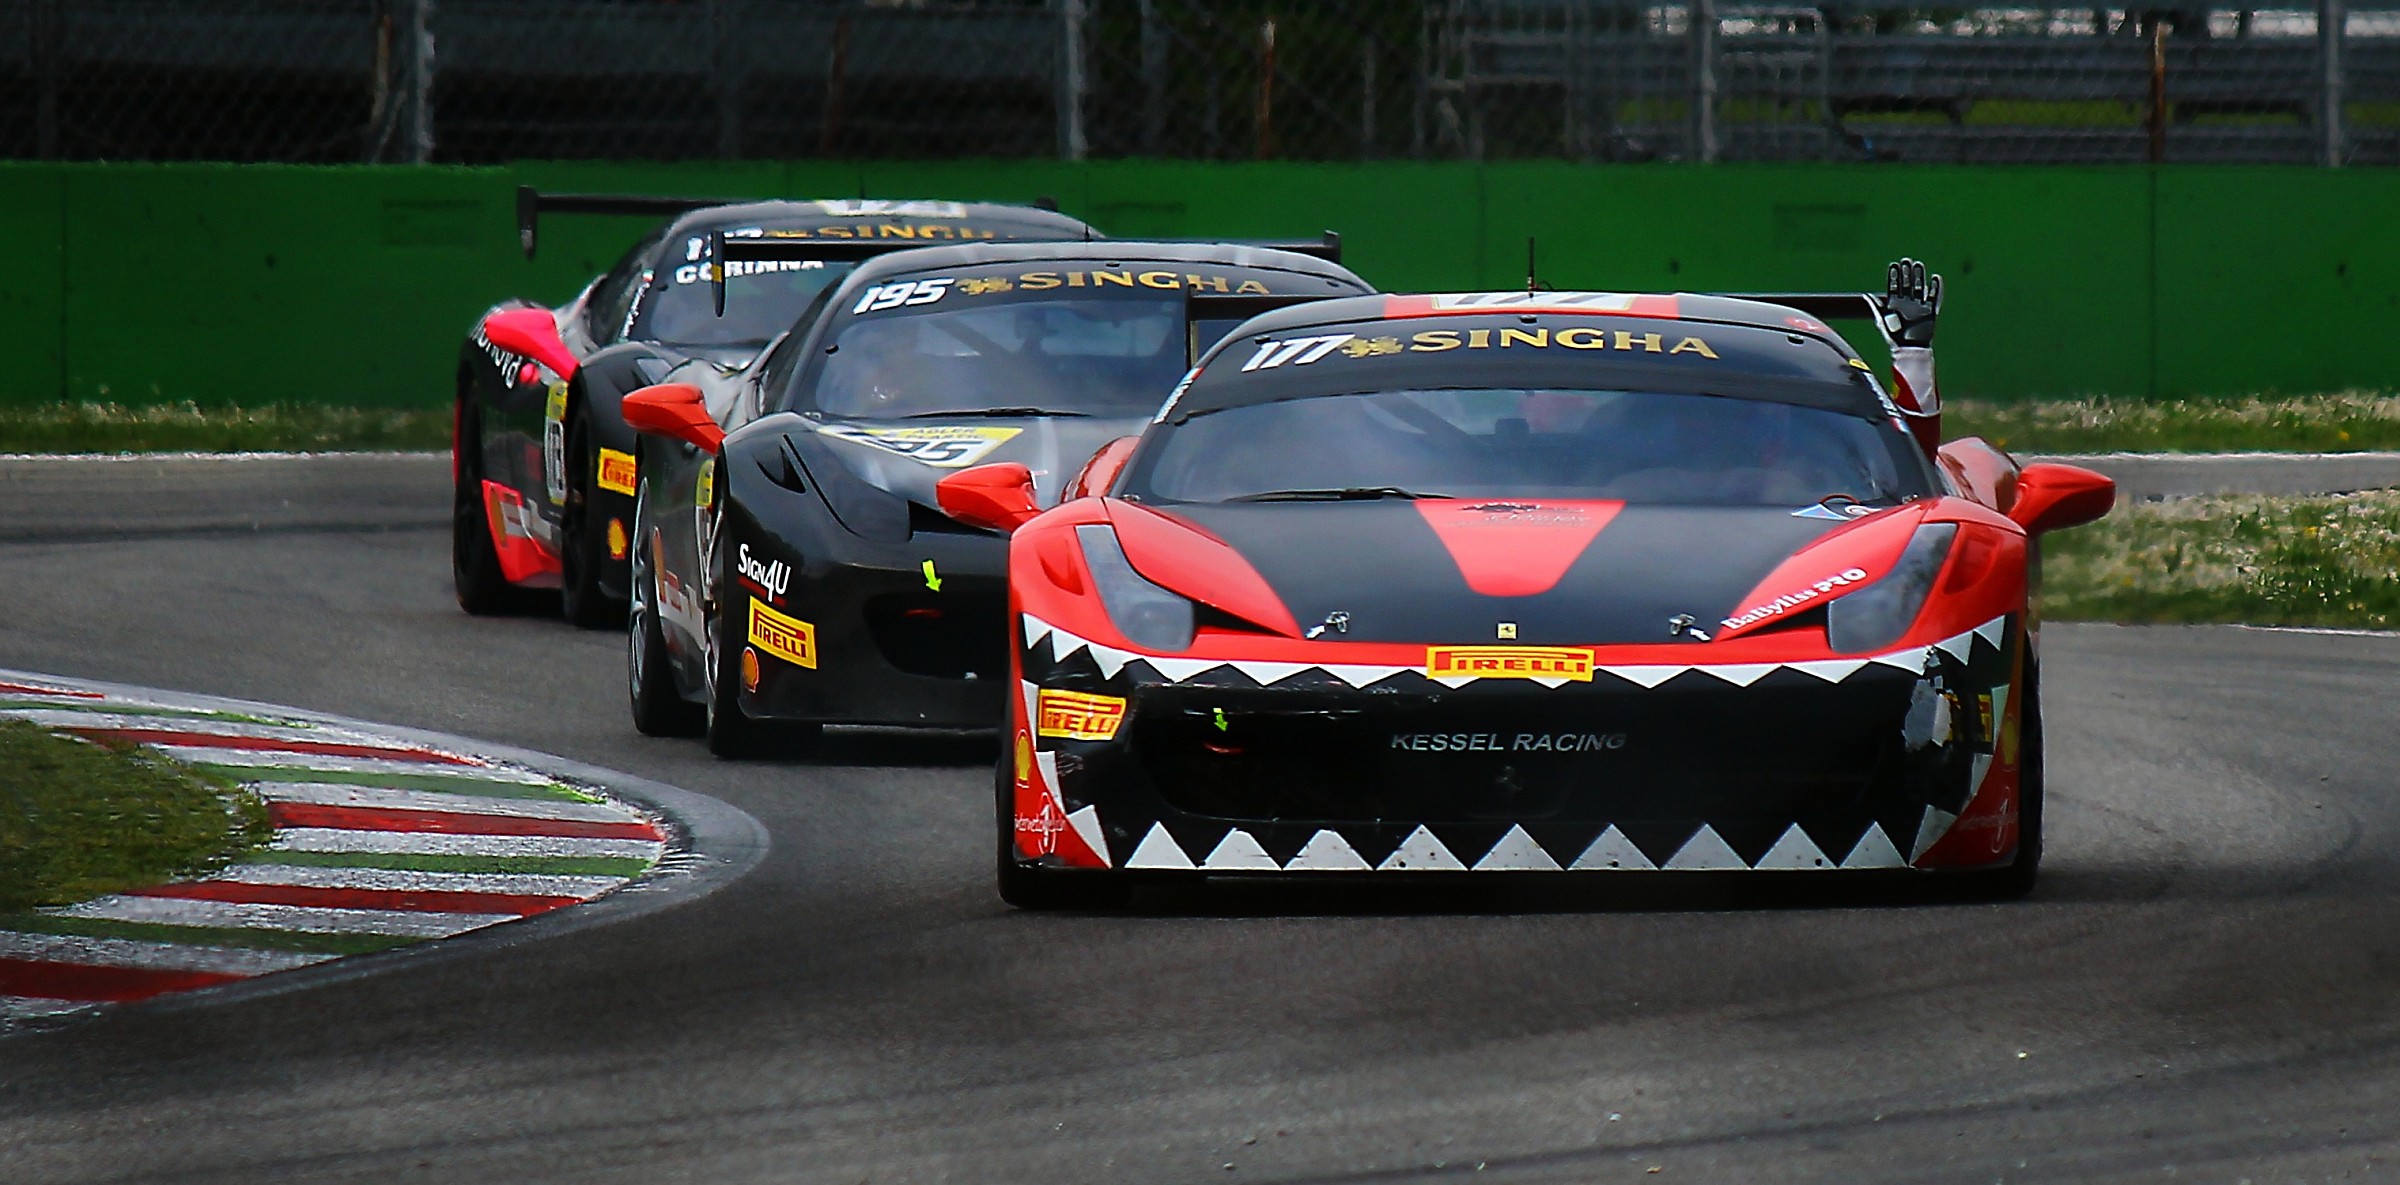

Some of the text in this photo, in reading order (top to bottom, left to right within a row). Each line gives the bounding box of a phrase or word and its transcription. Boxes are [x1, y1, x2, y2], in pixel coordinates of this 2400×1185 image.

[817, 224, 1016, 239] SING
[853, 271, 1270, 315] 195 SINGHA
[1241, 328, 1719, 372] 177 SINGHA
[753, 607, 807, 658] PIRELLI
[1435, 651, 1588, 673] PIRELLI
[1041, 696, 1122, 733] PIRELLI
[1392, 733, 1627, 751] KESSEL RACING
